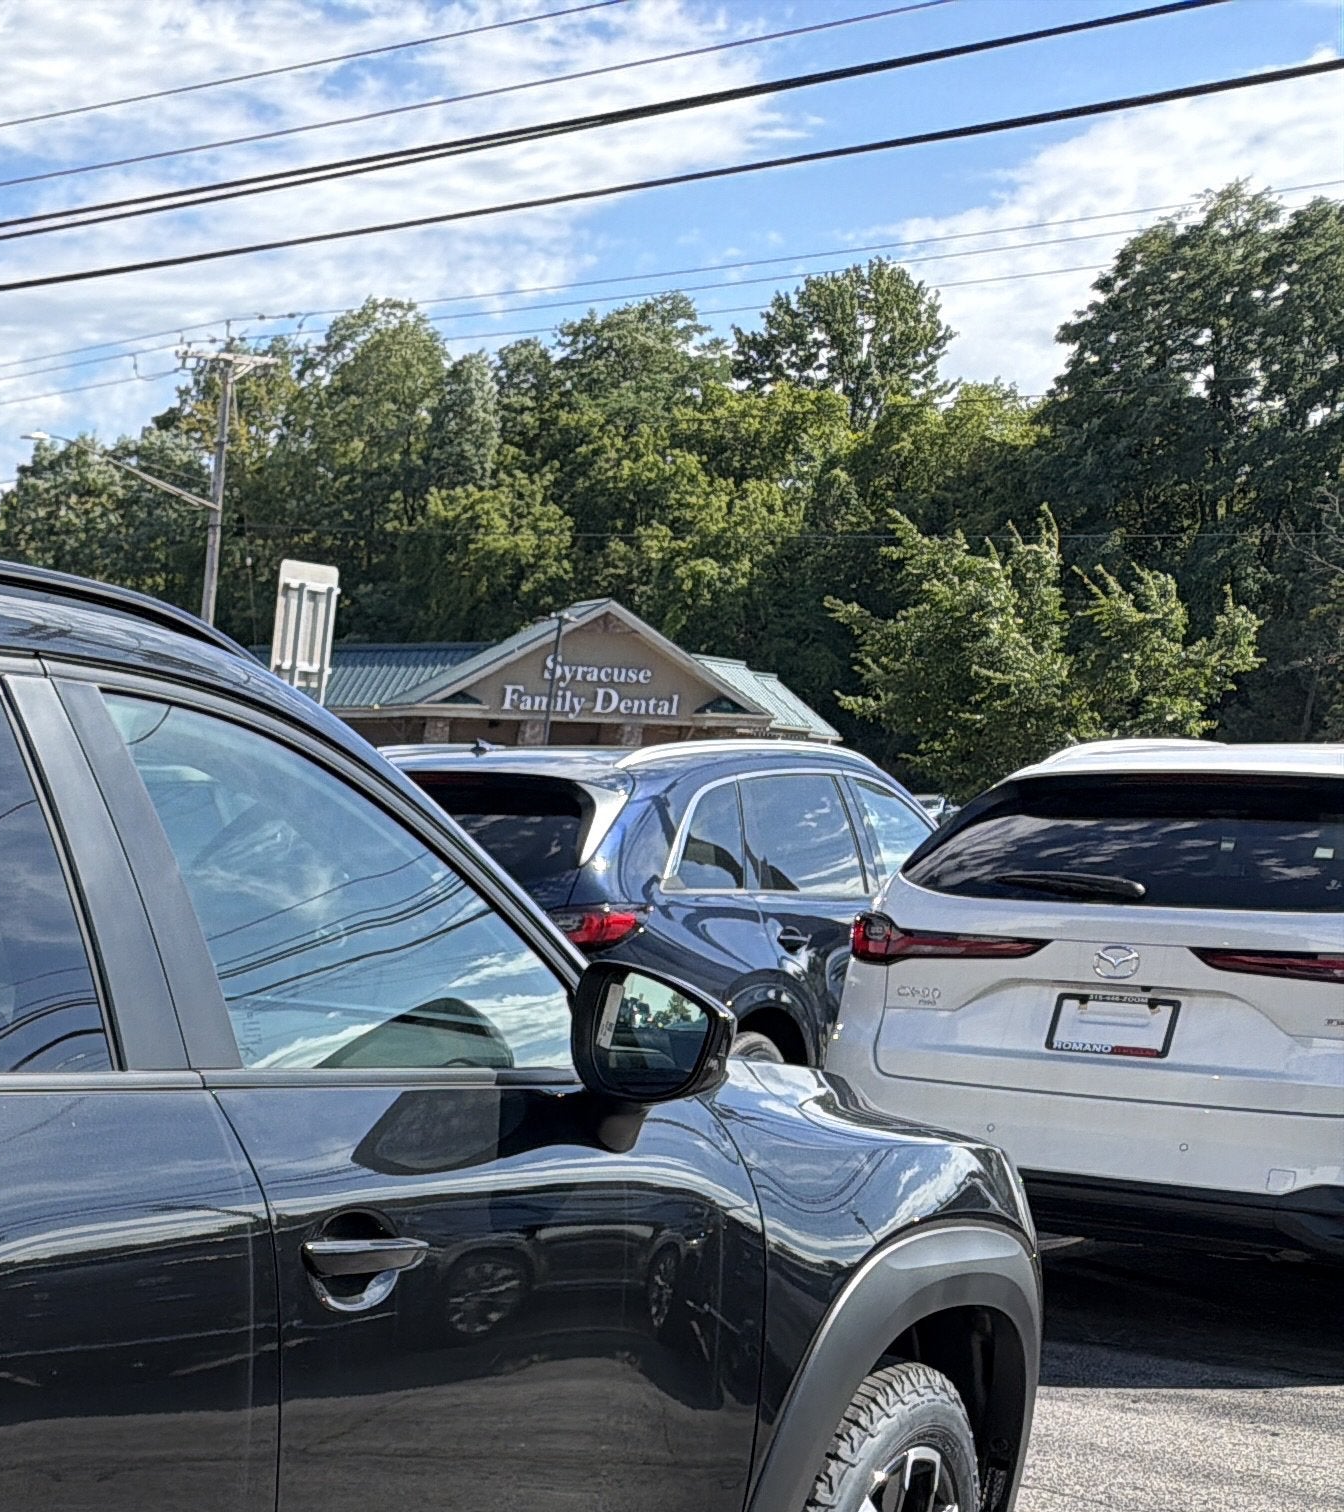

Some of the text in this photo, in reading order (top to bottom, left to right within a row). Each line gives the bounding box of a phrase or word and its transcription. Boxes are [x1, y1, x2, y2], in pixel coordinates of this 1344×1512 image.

[543, 653, 653, 688] Syracuse
[501, 684, 680, 719] Family Dental
